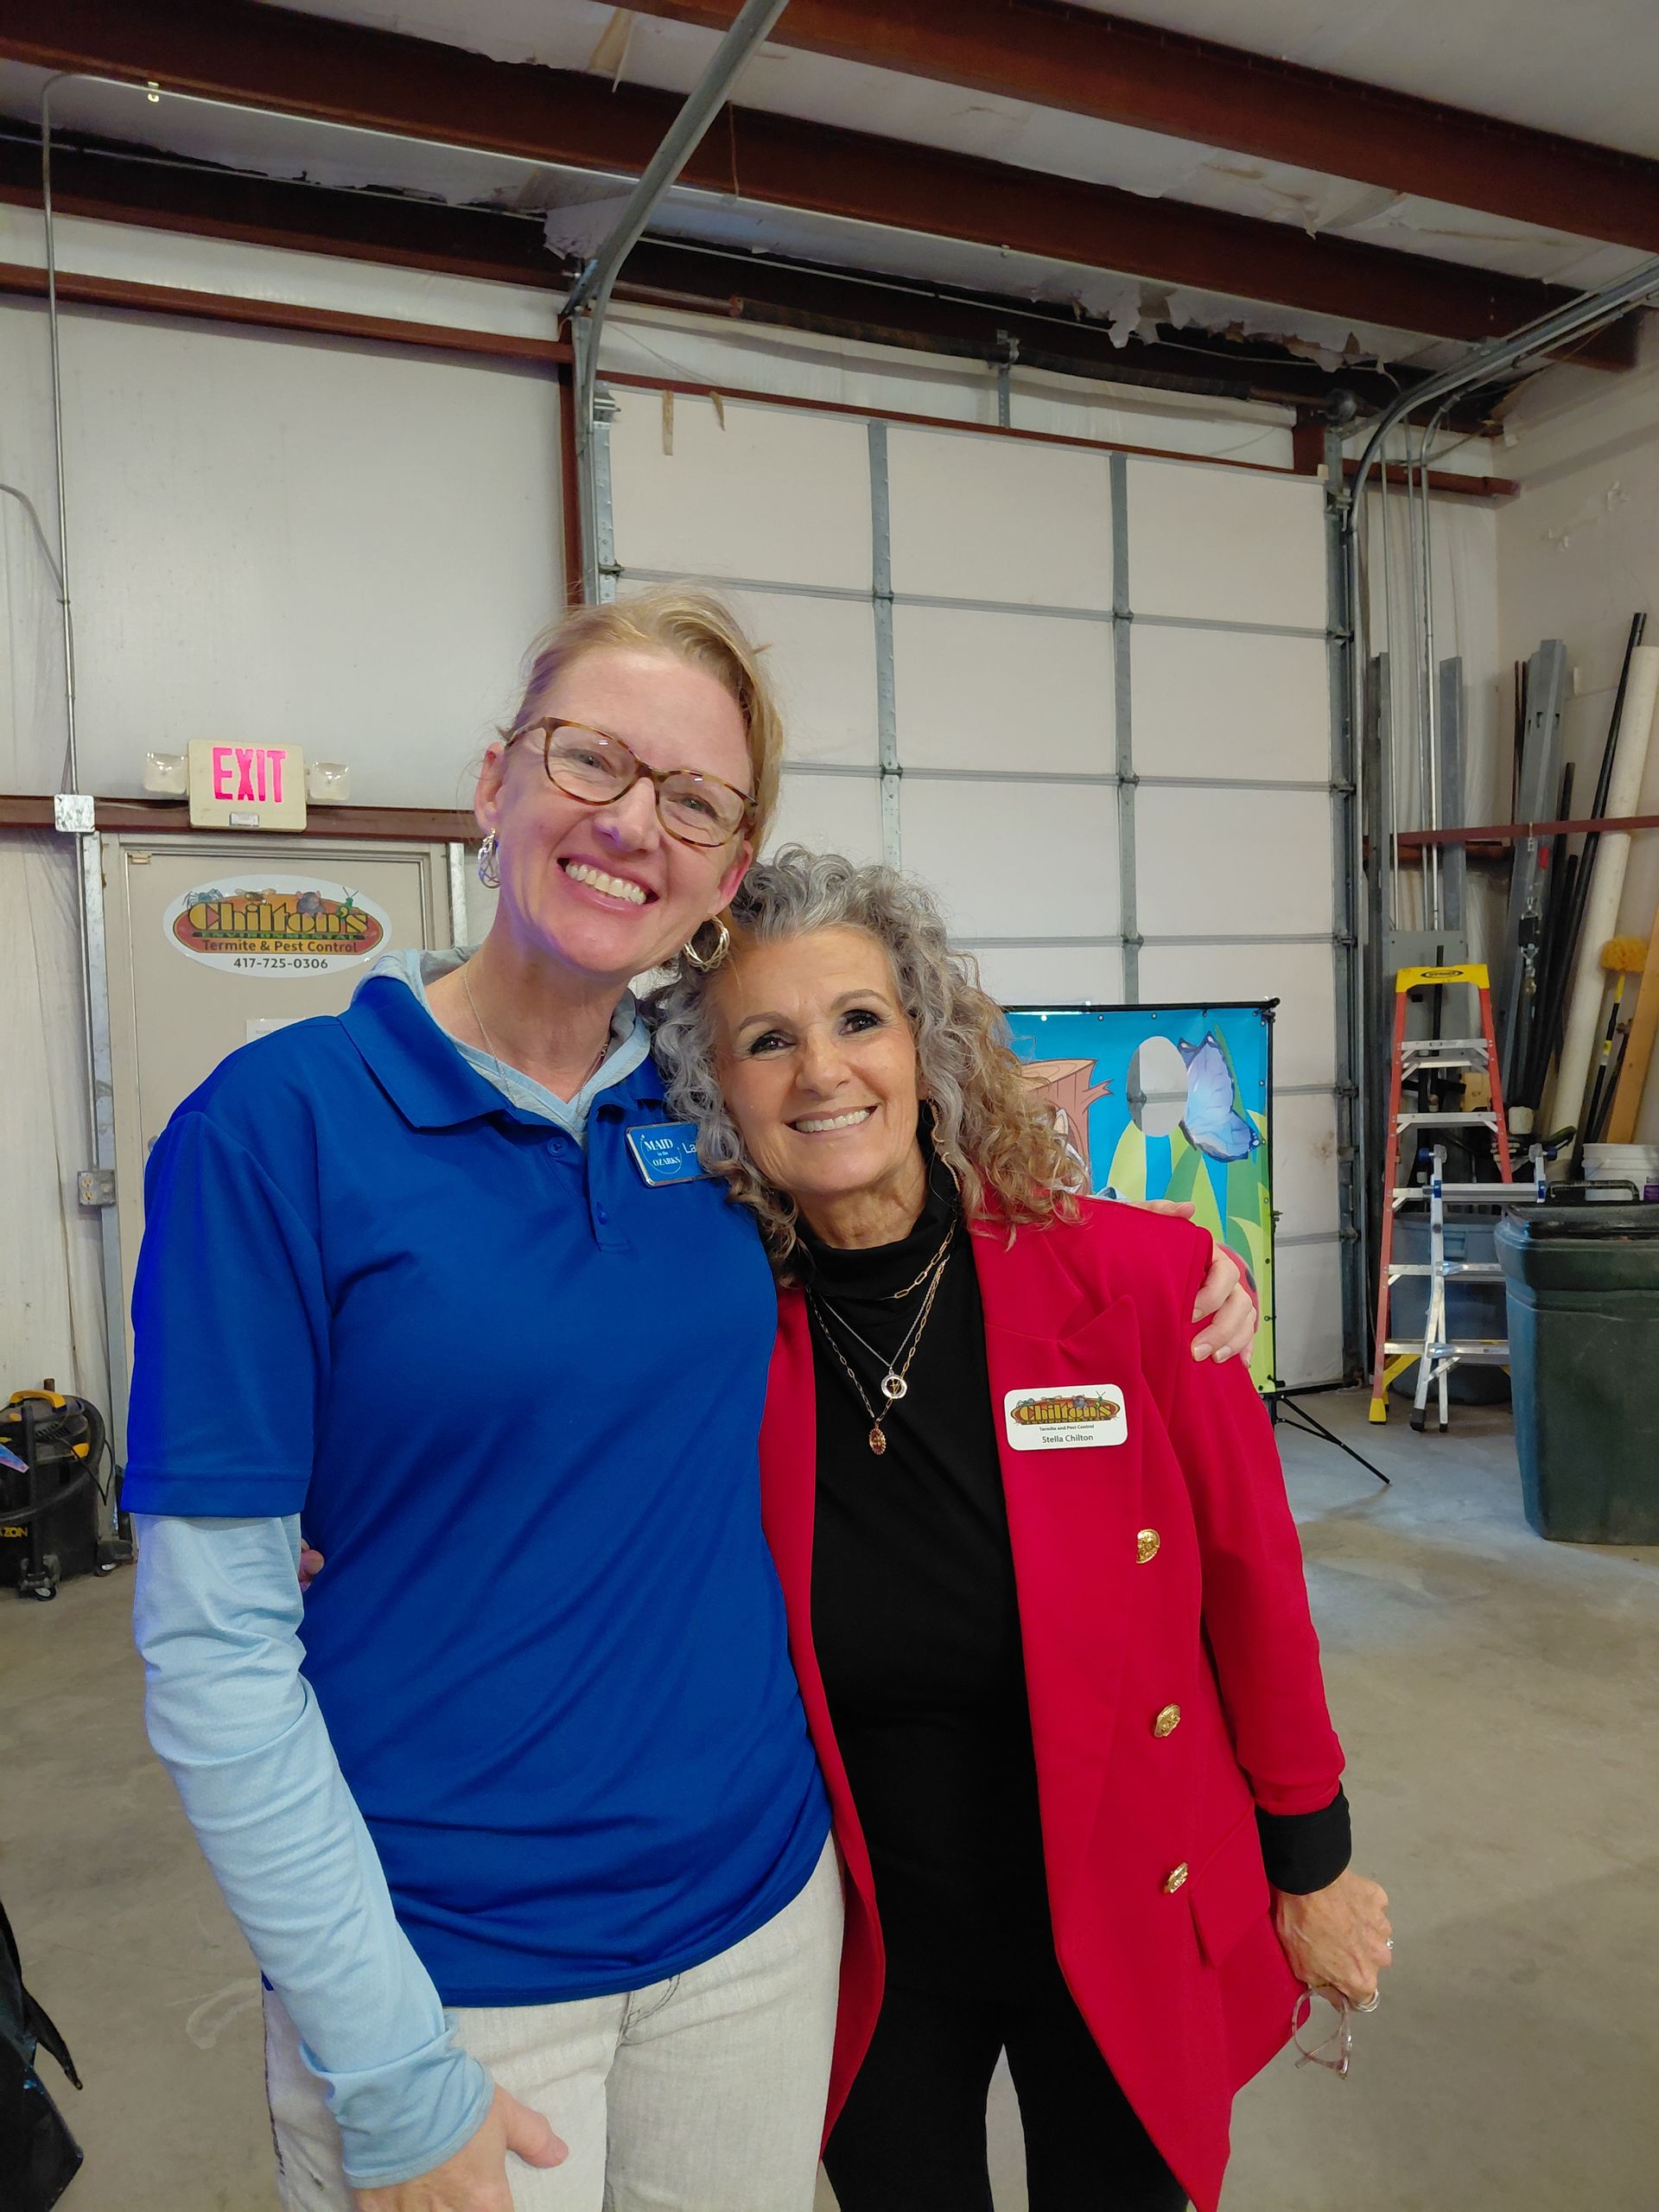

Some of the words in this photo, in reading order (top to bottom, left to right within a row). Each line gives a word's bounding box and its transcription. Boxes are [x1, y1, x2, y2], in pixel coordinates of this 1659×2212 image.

[212, 747, 287, 803] EXIT
[188, 902, 369, 934] Chilton's
[201, 939, 257, 950] Termite
[259, 940, 270, 951] &
[274, 940, 303, 951] Pest
[307, 941, 357, 953] Control
[233, 957, 328, 969] 417-725-0306
[644, 1139, 673, 1152] MAID
[652, 1156, 681, 1166] OZARKS
[1020, 1402, 1111, 1421] Chilton's
[1042, 1435, 1064, 1444] Stella
[1065, 1433, 1094, 1443] Chilton
